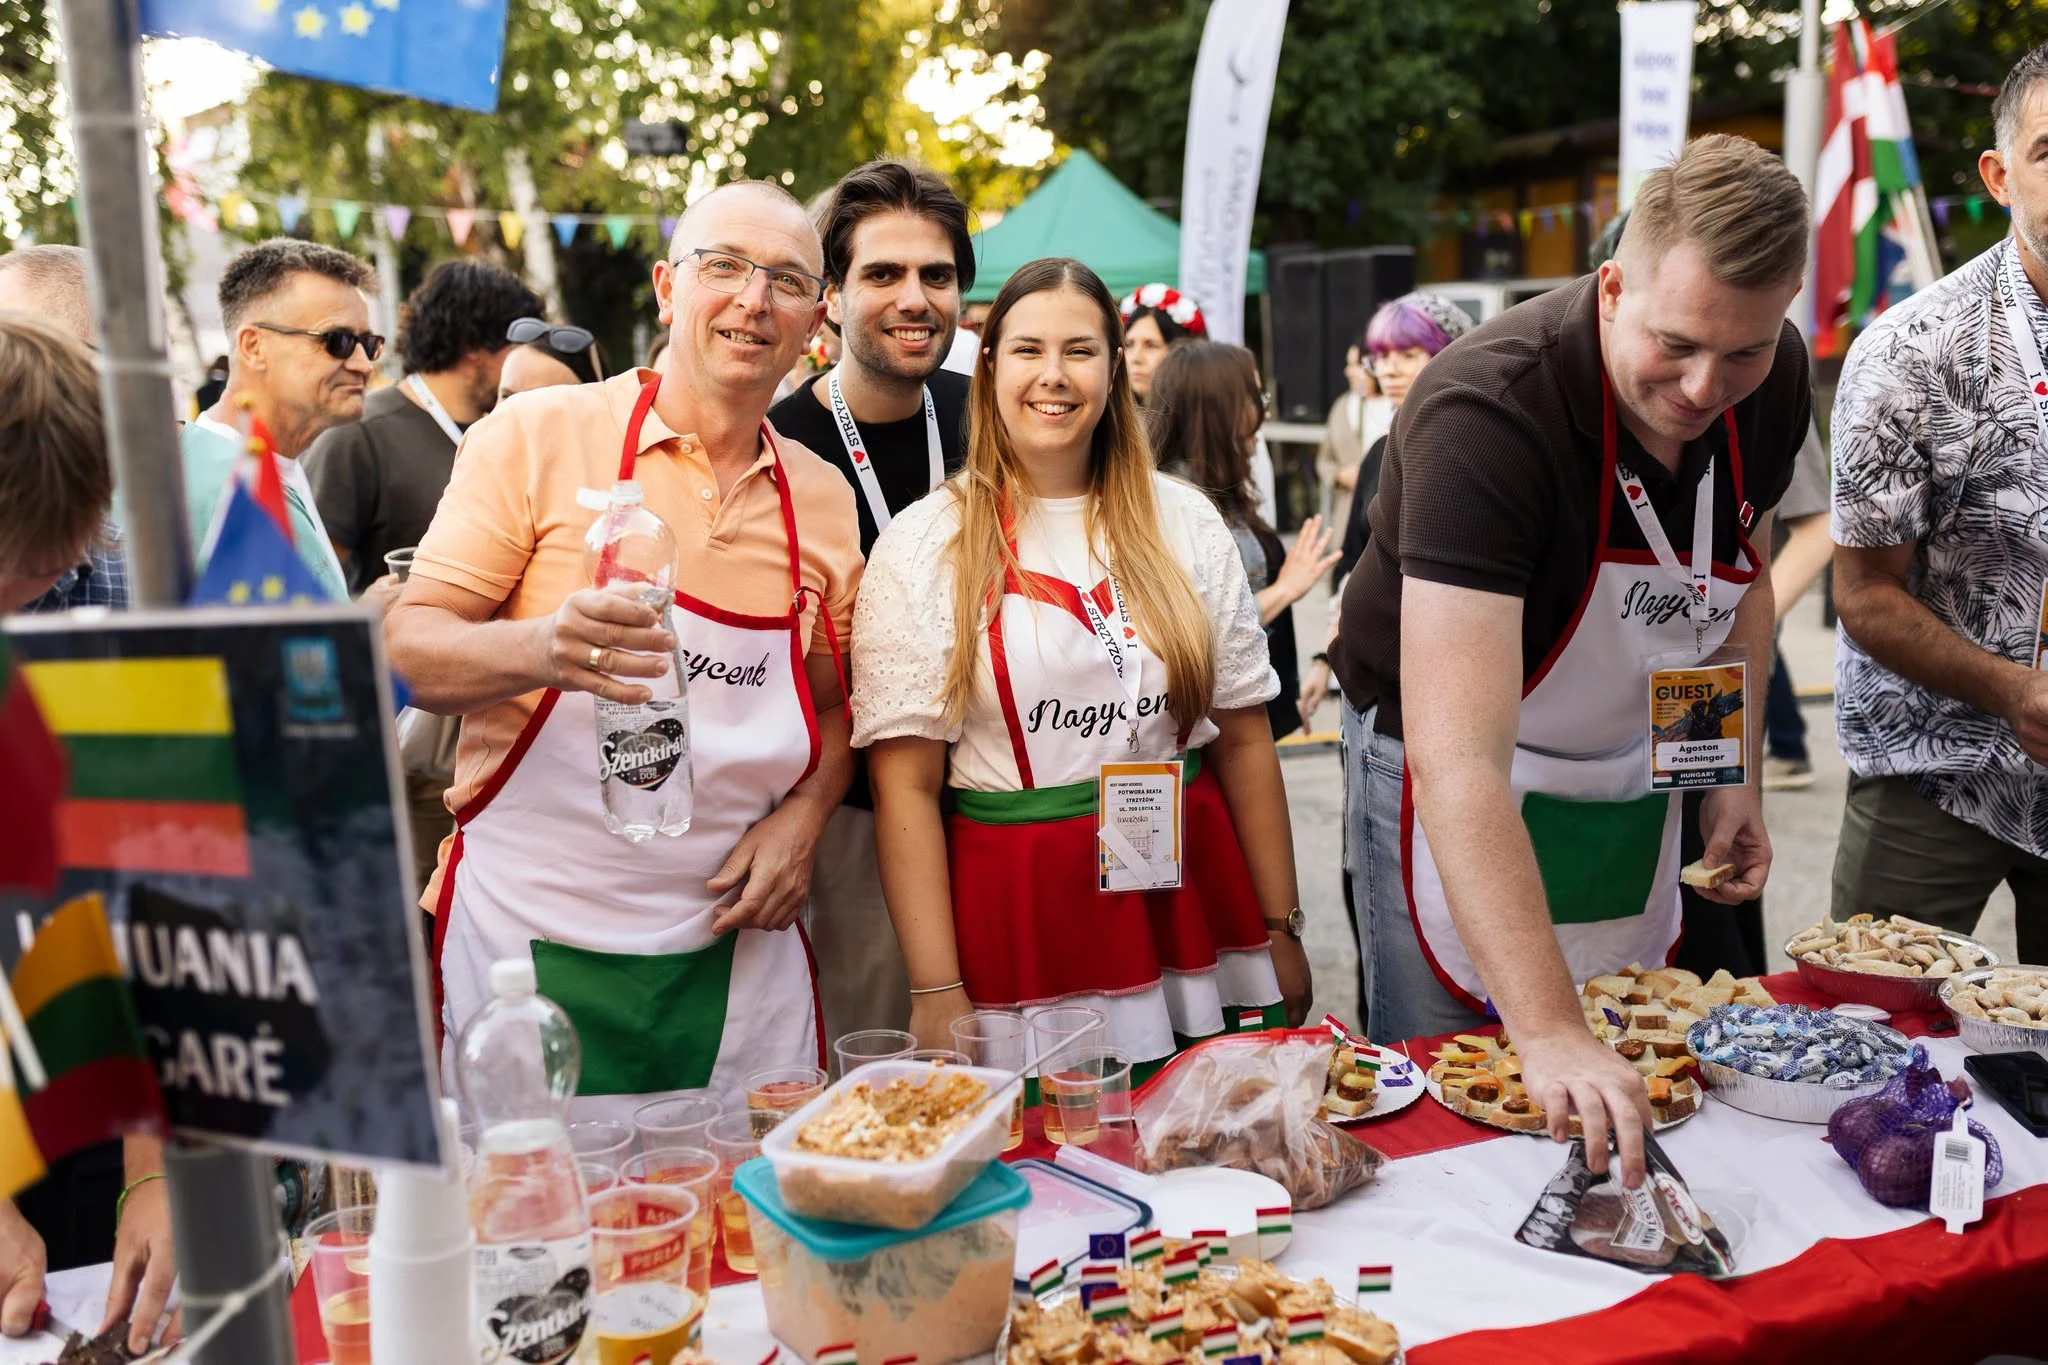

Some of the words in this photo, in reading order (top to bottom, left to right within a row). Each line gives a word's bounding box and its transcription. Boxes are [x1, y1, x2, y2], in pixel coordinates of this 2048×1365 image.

[1656, 683, 1714, 700] GUEST
[1027, 692, 1169, 738] Nagycen
[600, 734, 686, 781] Szentkirál
[1671, 754, 1725, 764] Poschinger
[1680, 771, 1716, 779] HUNGARY
